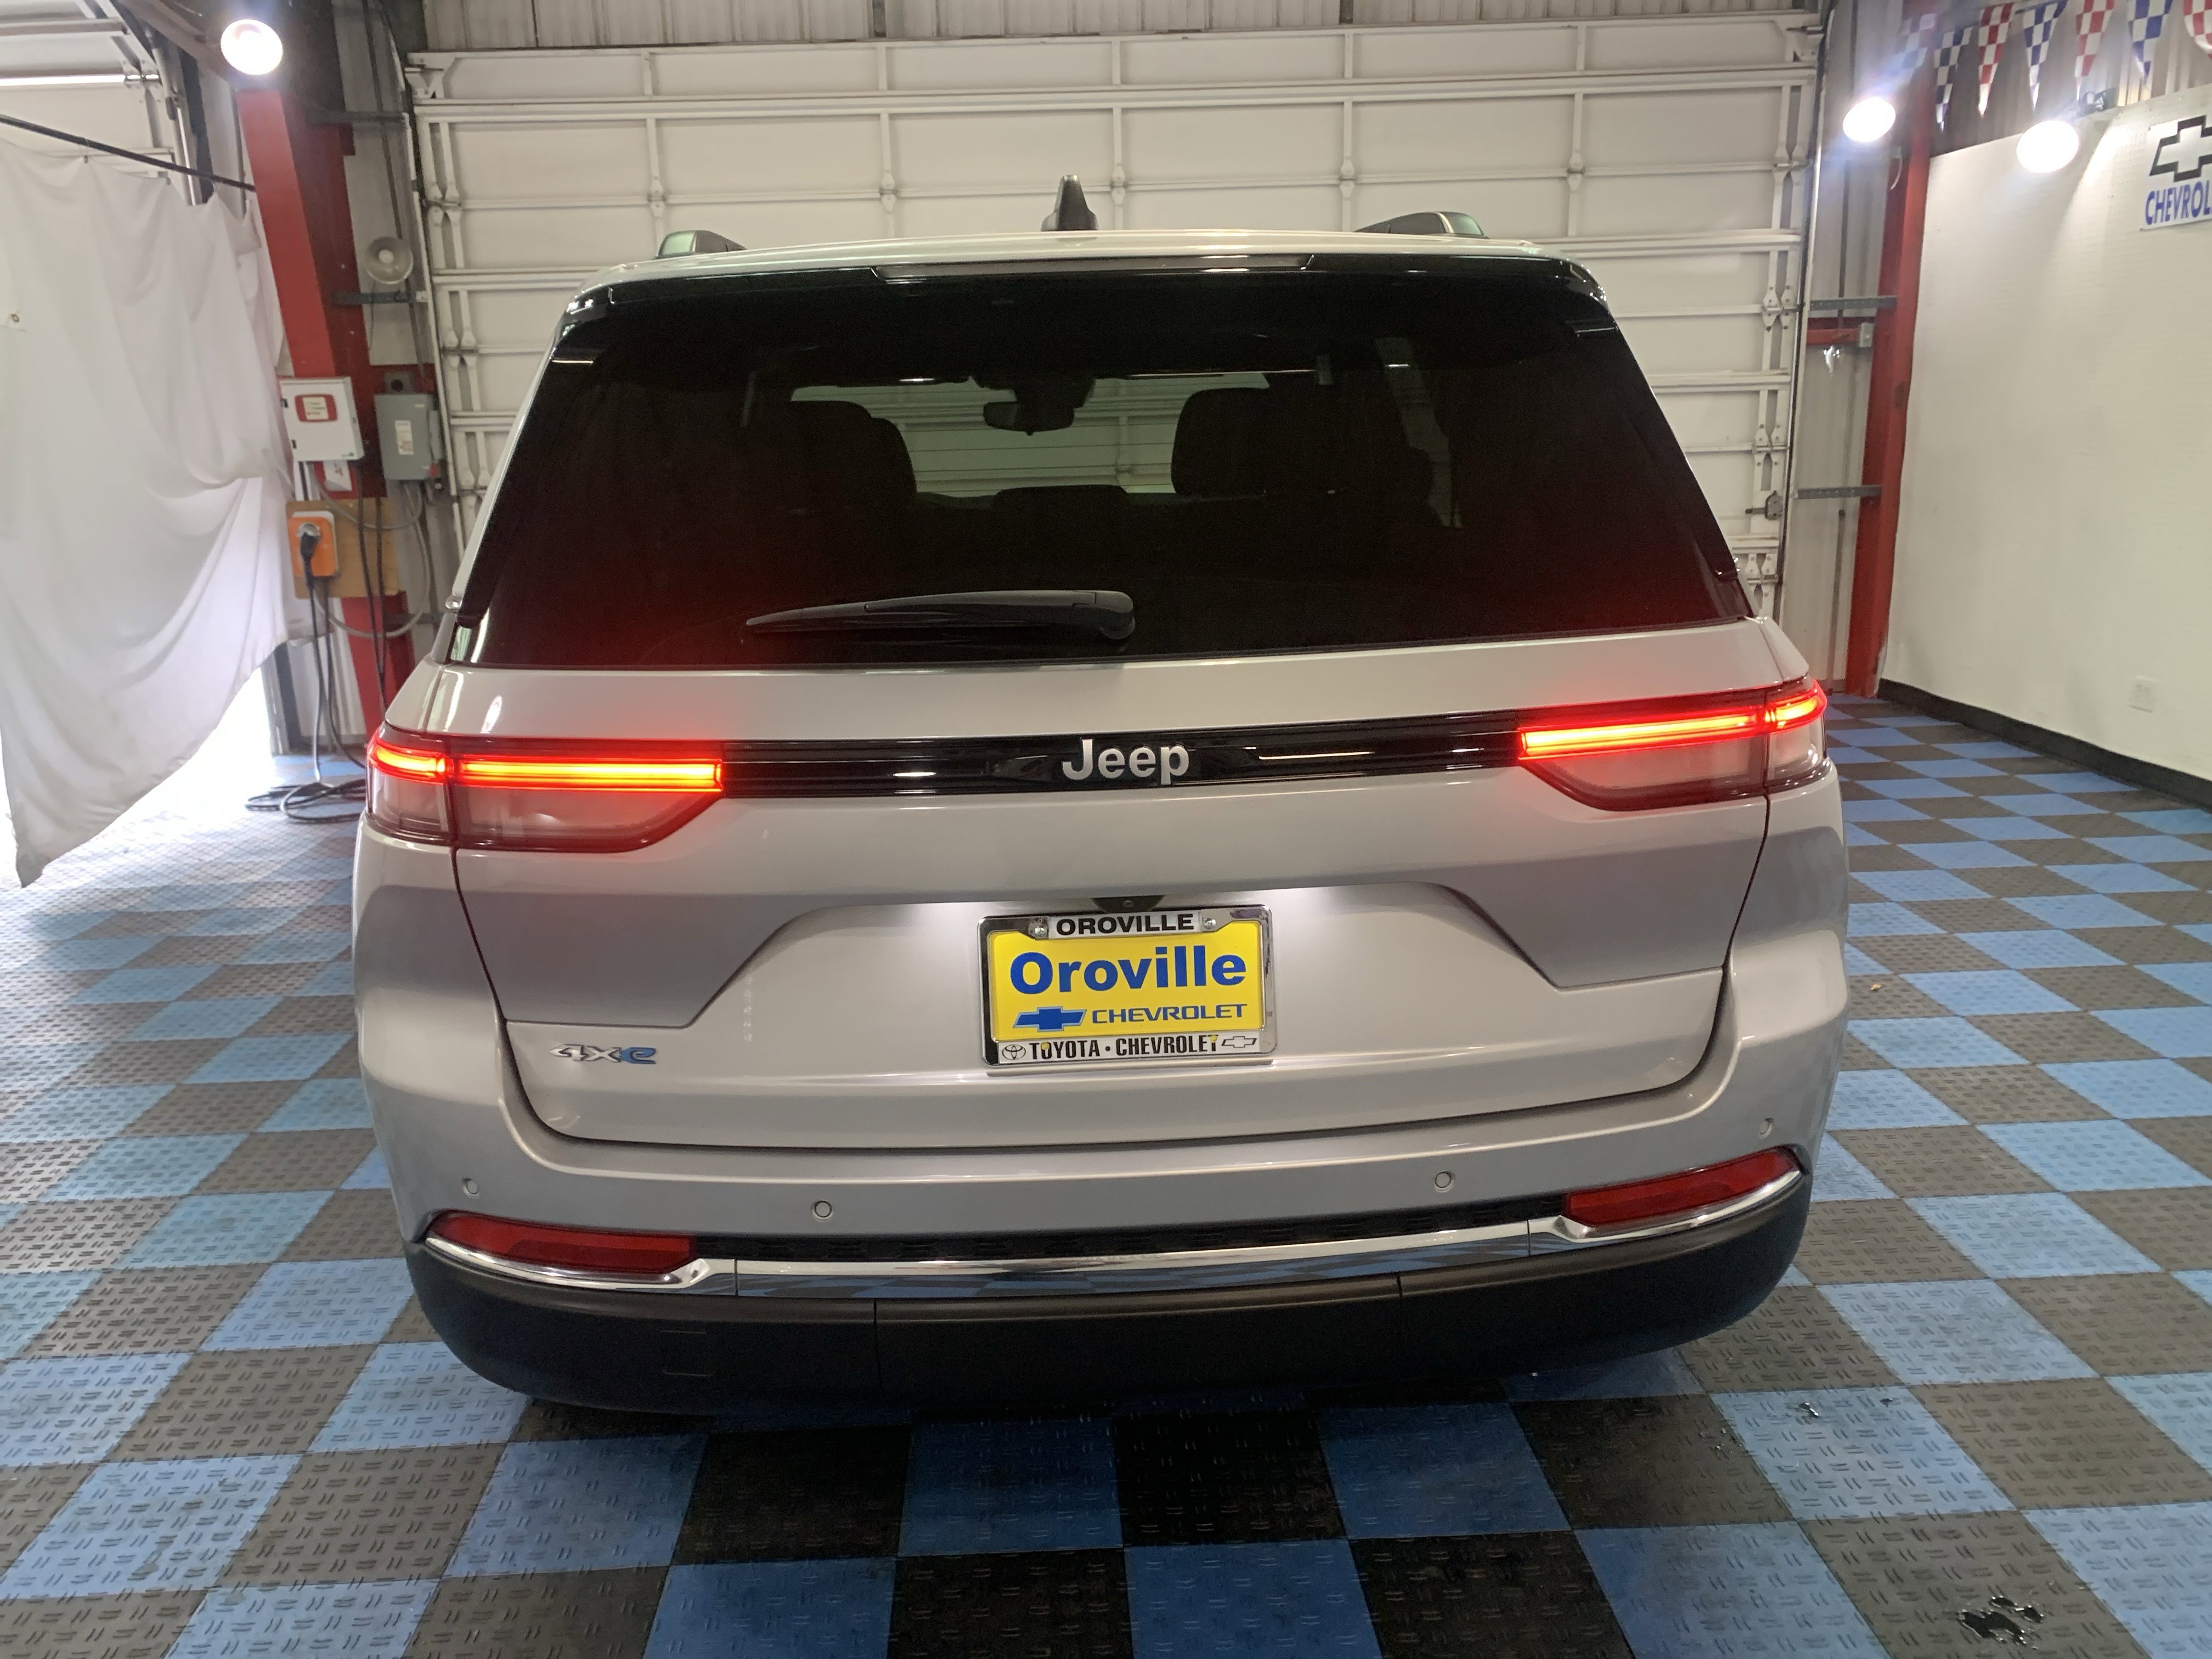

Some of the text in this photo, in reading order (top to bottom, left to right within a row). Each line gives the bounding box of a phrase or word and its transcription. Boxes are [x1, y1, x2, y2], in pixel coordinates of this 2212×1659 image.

[2145, 180, 2212, 225] CHEVROL
[1062, 738, 1189, 785] Jeep
[1056, 913, 1194, 935] OROVILLE
[1010, 945, 1246, 995] Oroville
[1092, 1003, 1248, 1024] CHEVROLET
[1029, 1034, 1220, 1060] TOYOTA CHEVROLET
